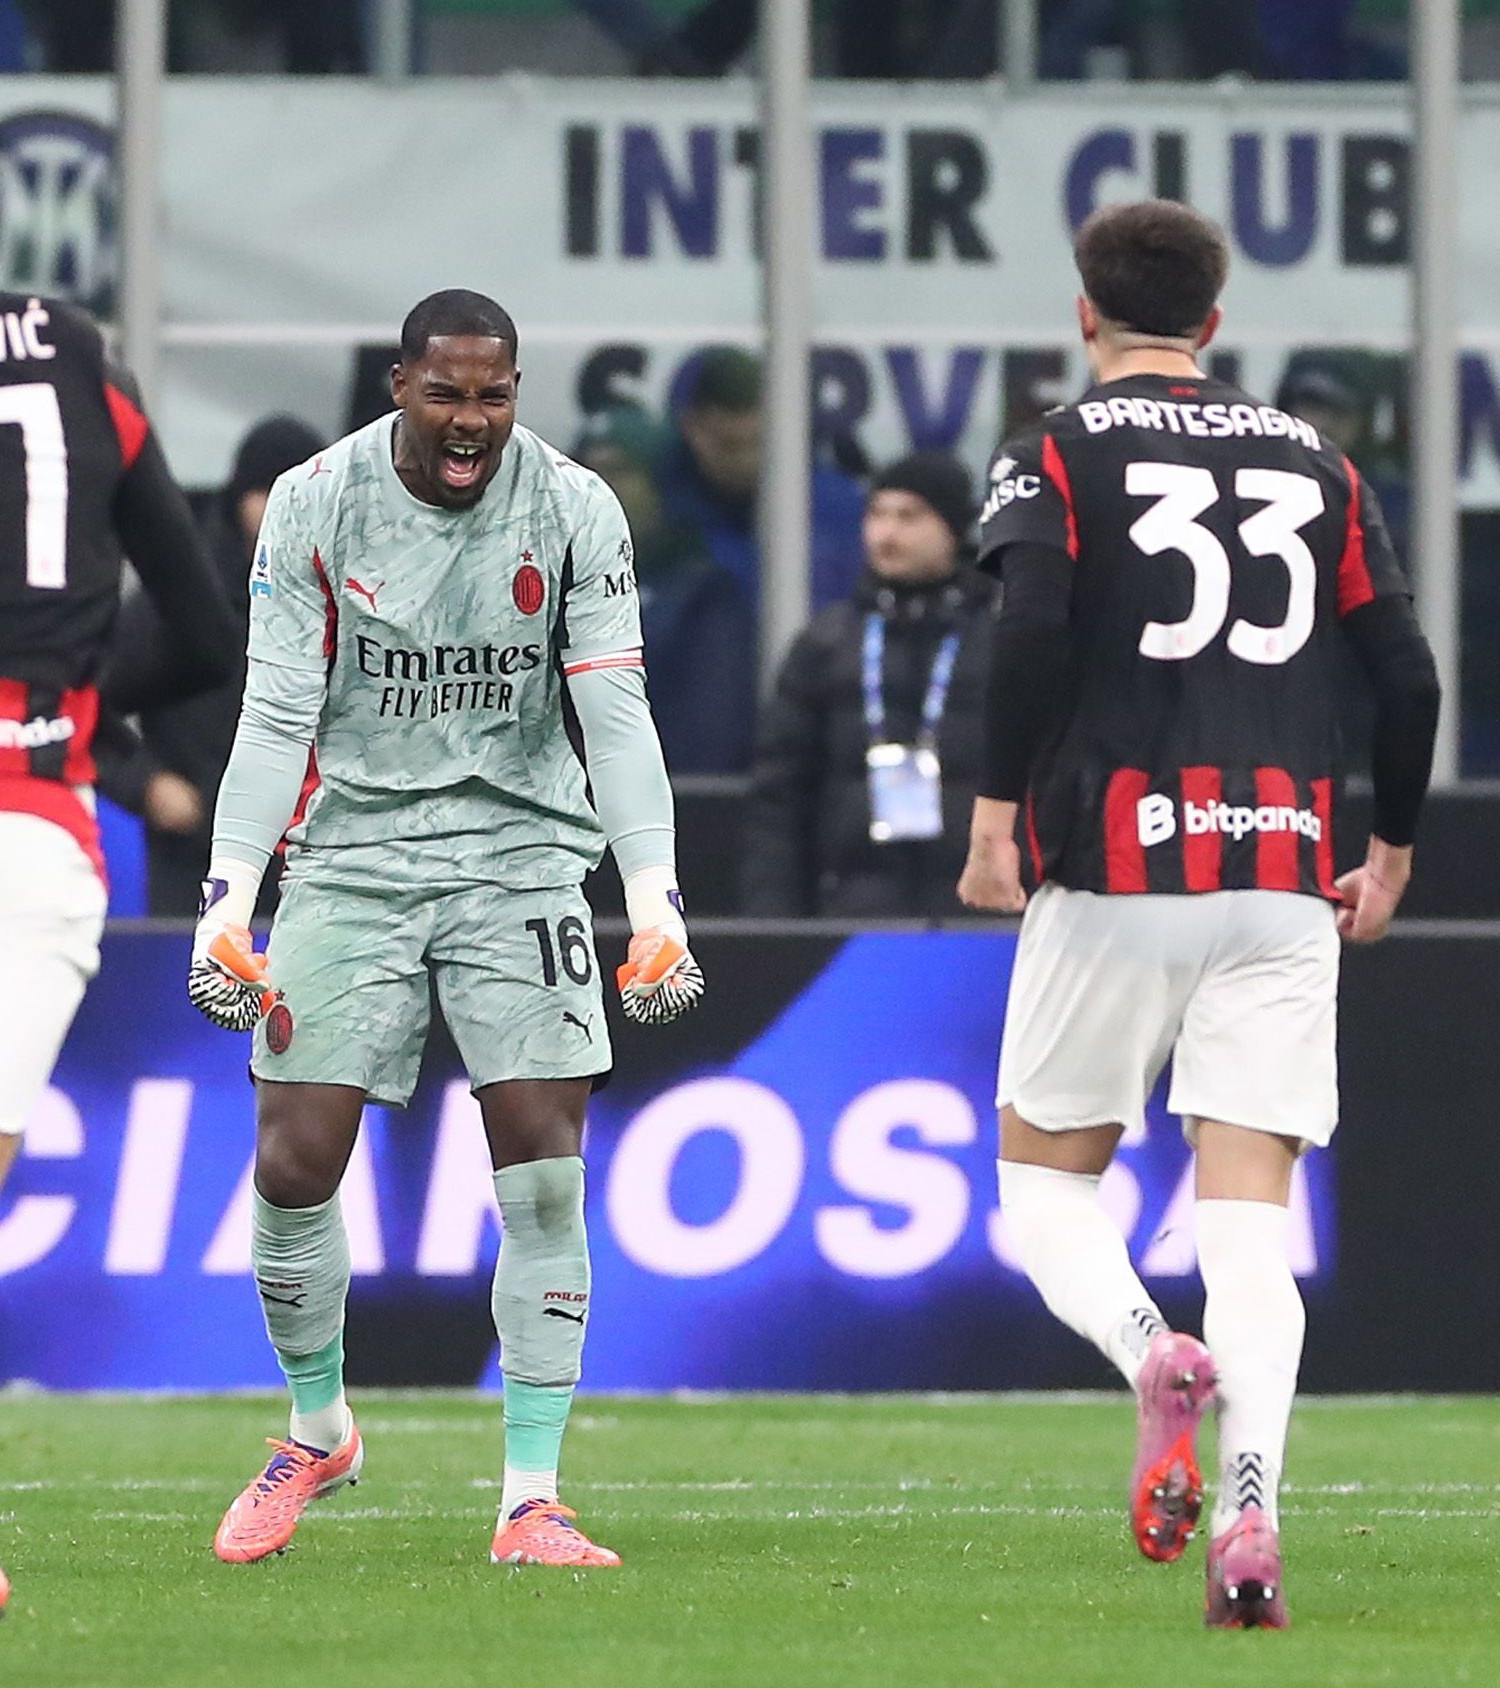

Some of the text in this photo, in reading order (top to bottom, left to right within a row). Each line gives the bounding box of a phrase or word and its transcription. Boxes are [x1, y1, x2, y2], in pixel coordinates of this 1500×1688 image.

[1077, 396, 1323, 452] BARTESAGHI
[1124, 460, 1326, 666] 33
[356, 633, 542, 683] Emrates
[379, 681, 514, 719] FLY BETTER
[524, 915, 592, 987] 16
